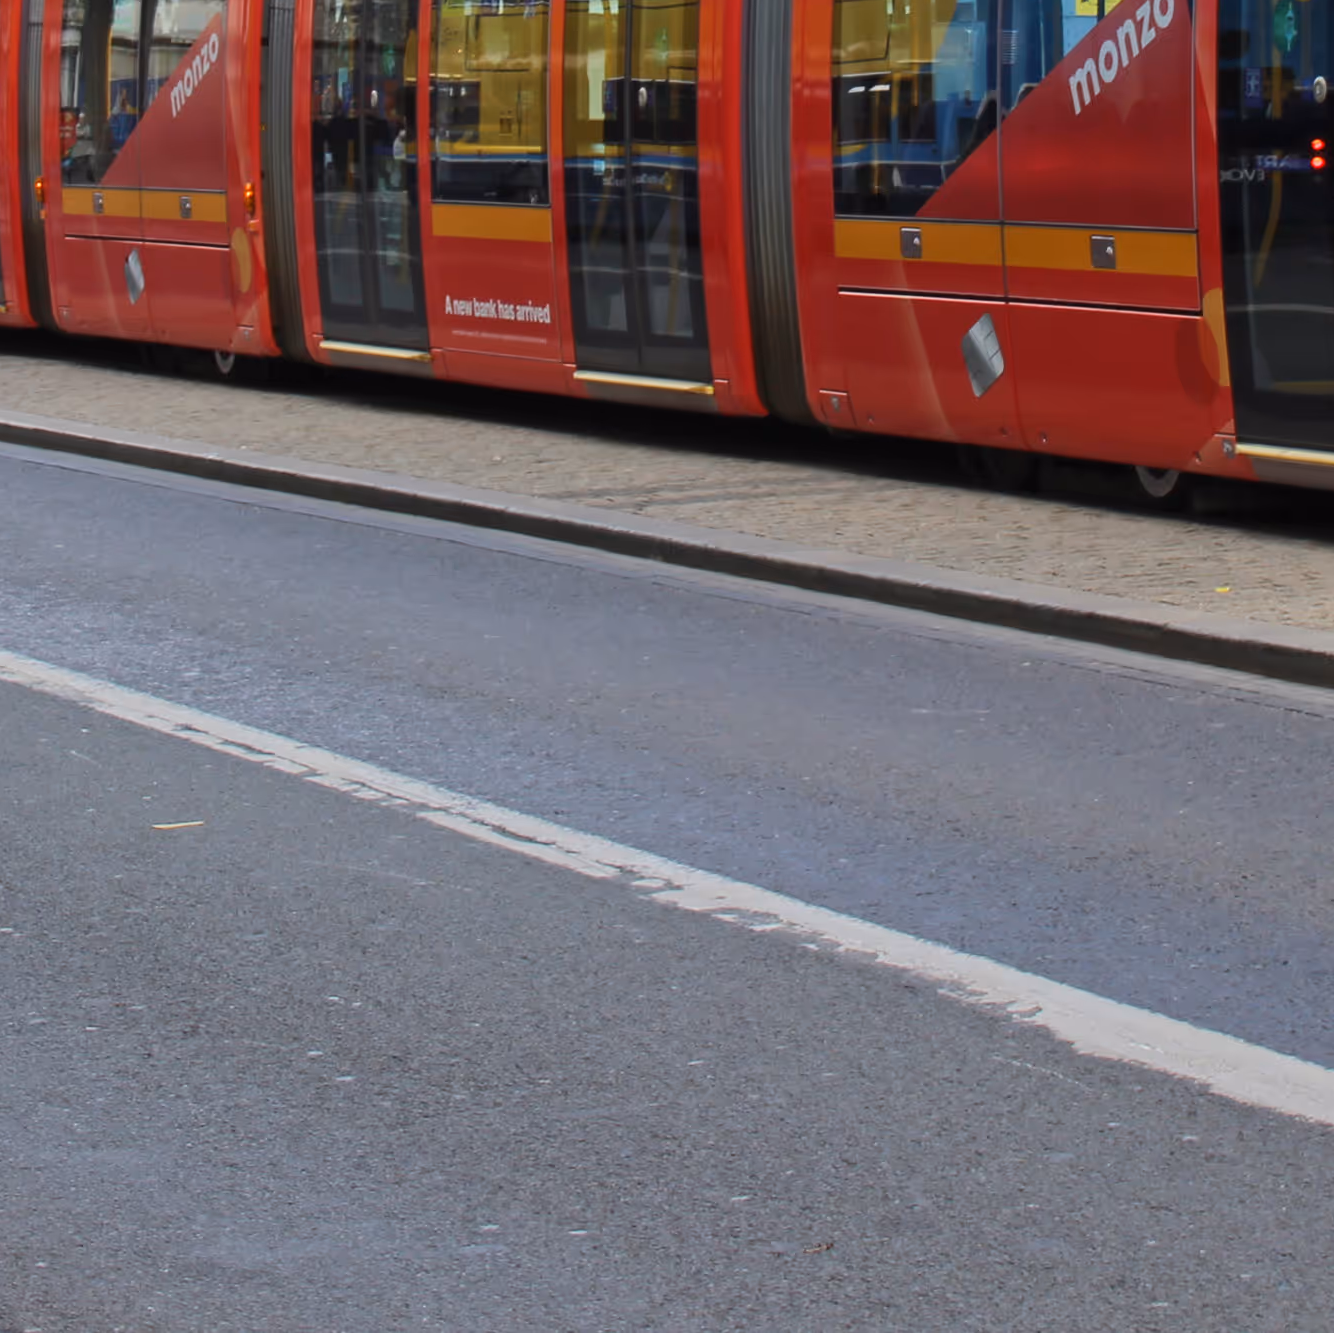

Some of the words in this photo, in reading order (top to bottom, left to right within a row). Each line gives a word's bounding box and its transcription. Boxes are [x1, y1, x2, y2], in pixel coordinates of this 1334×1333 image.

[171, 33, 219, 118] monzo
[445, 295, 452, 315] A
[453, 301, 472, 316] new
[473, 297, 497, 318] bank
[498, 300, 515, 320] has
[516, 301, 551, 324] arrived
